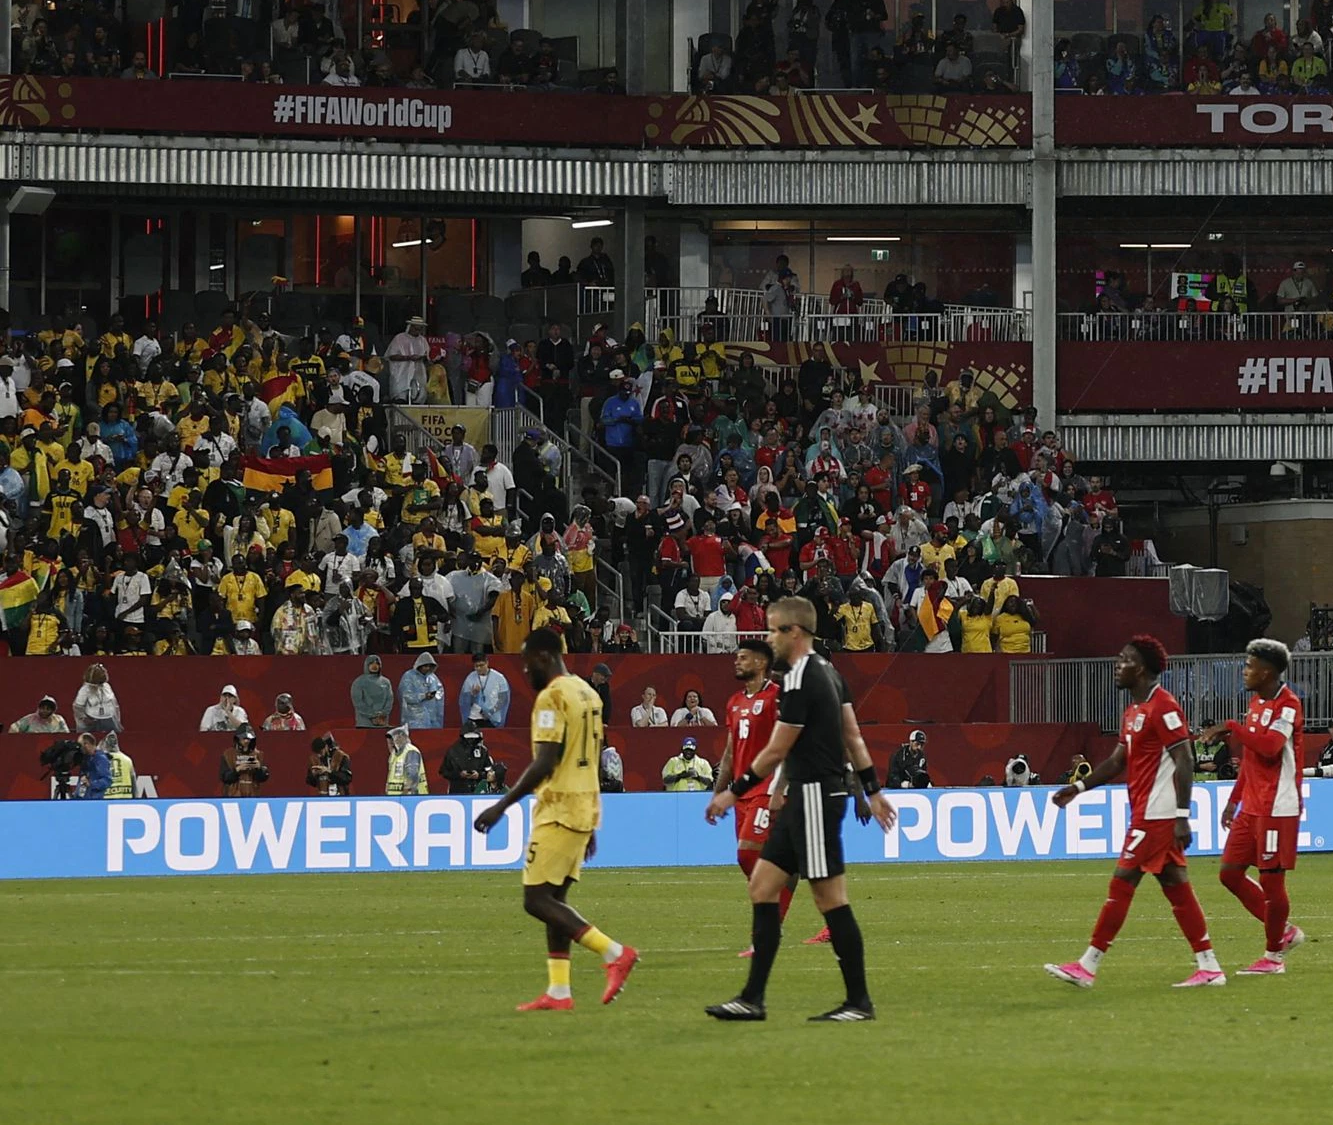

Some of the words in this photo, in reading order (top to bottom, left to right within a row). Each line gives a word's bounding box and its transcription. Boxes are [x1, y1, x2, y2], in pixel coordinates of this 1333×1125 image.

[273, 94, 452, 134] #FIFAWorldCup
[422, 416, 446, 425] FIFA
[739, 717, 750, 738] 16
[753, 805, 771, 827] 16
[107, 798, 536, 872] POWERAD
[1126, 829, 1146, 852] 7
[1265, 830, 1278, 853] 11
